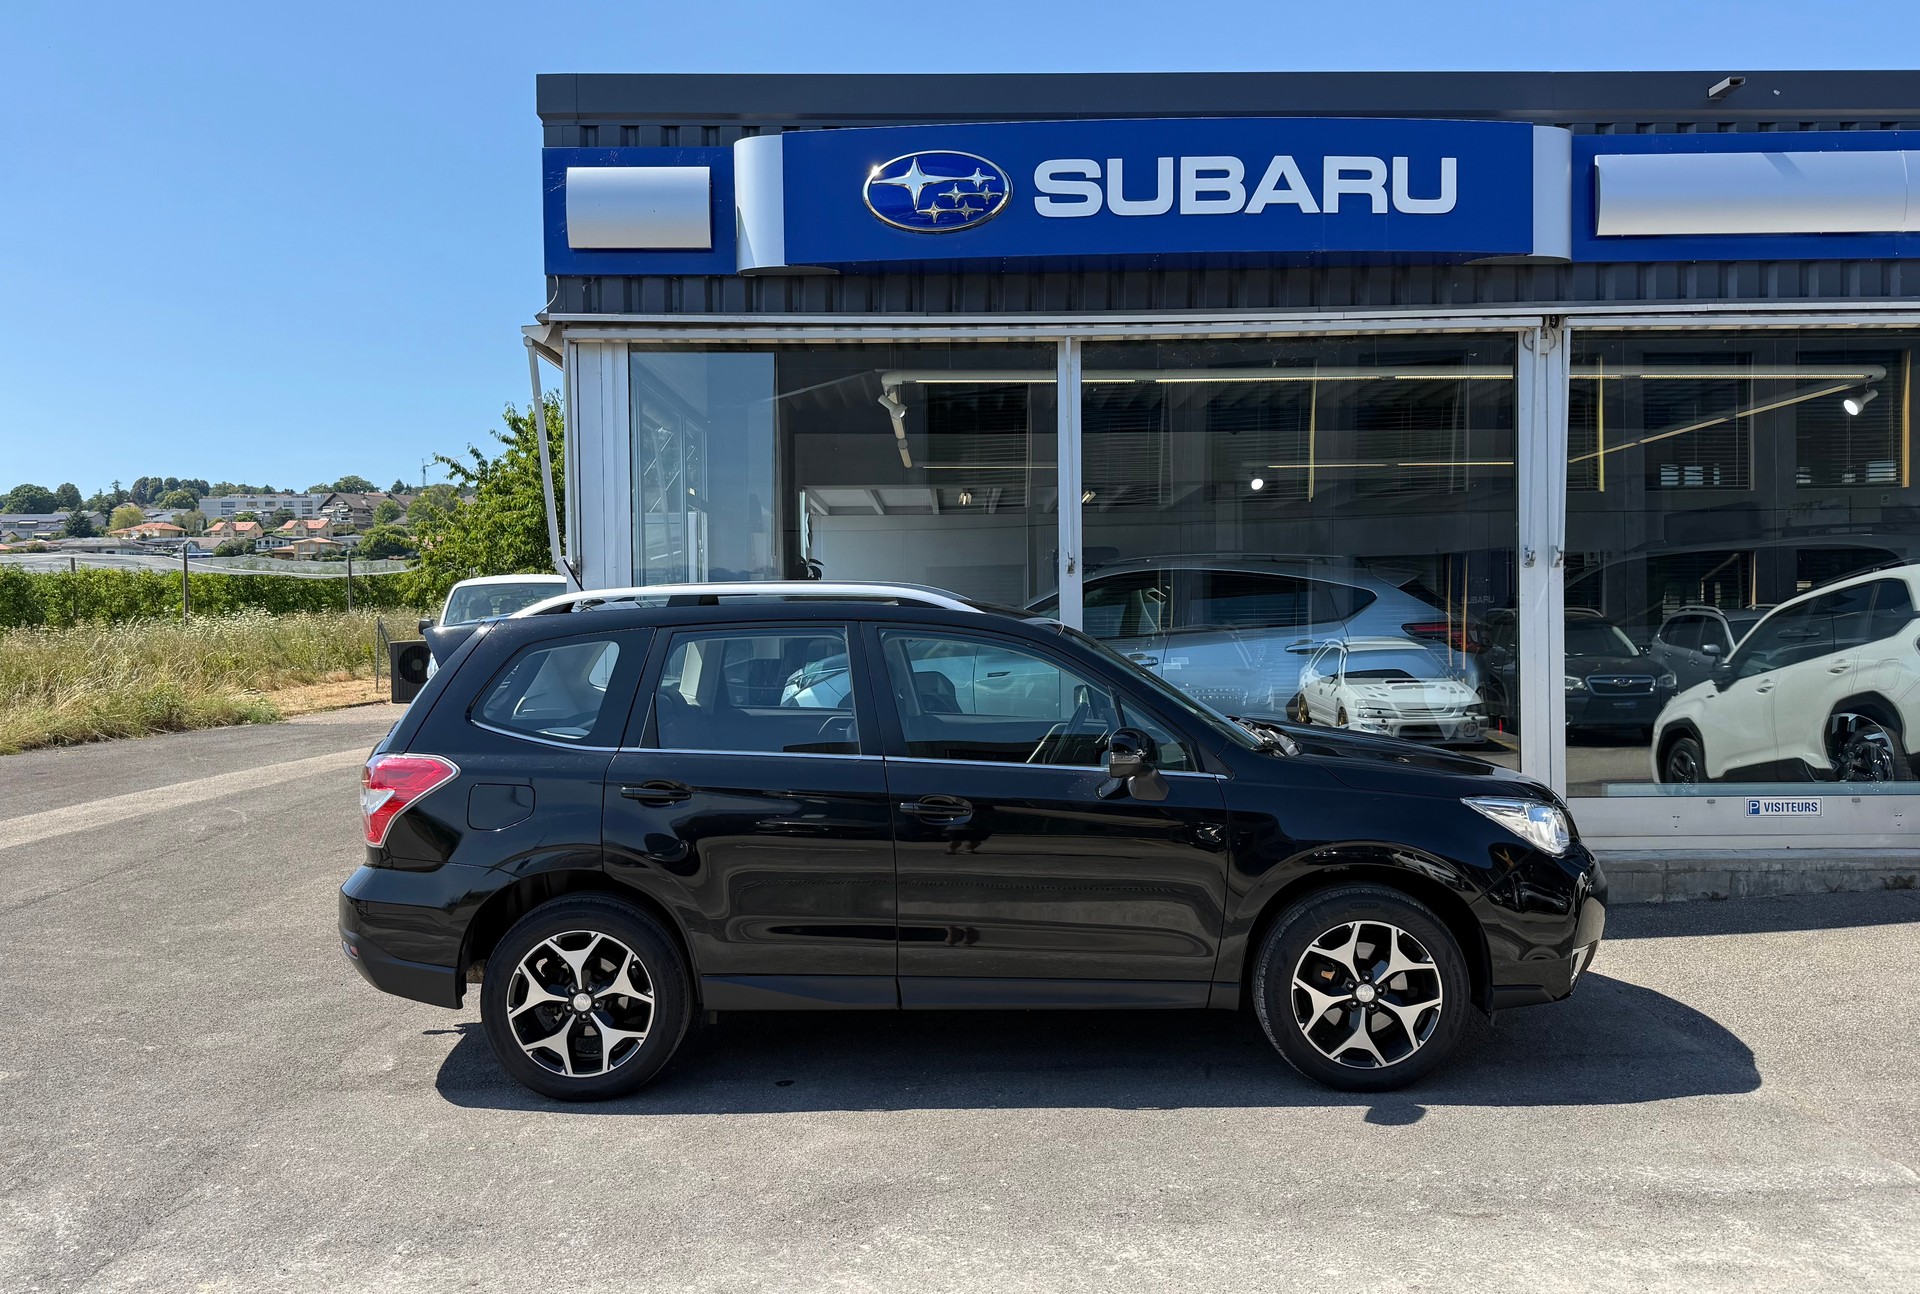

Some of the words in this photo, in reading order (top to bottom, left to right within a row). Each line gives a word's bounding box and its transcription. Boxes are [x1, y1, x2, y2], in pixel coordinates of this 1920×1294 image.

[1034, 155, 1457, 218] SUBARU
[1749, 801, 1759, 813] P
[1764, 802, 1818, 812] VISITEURS
